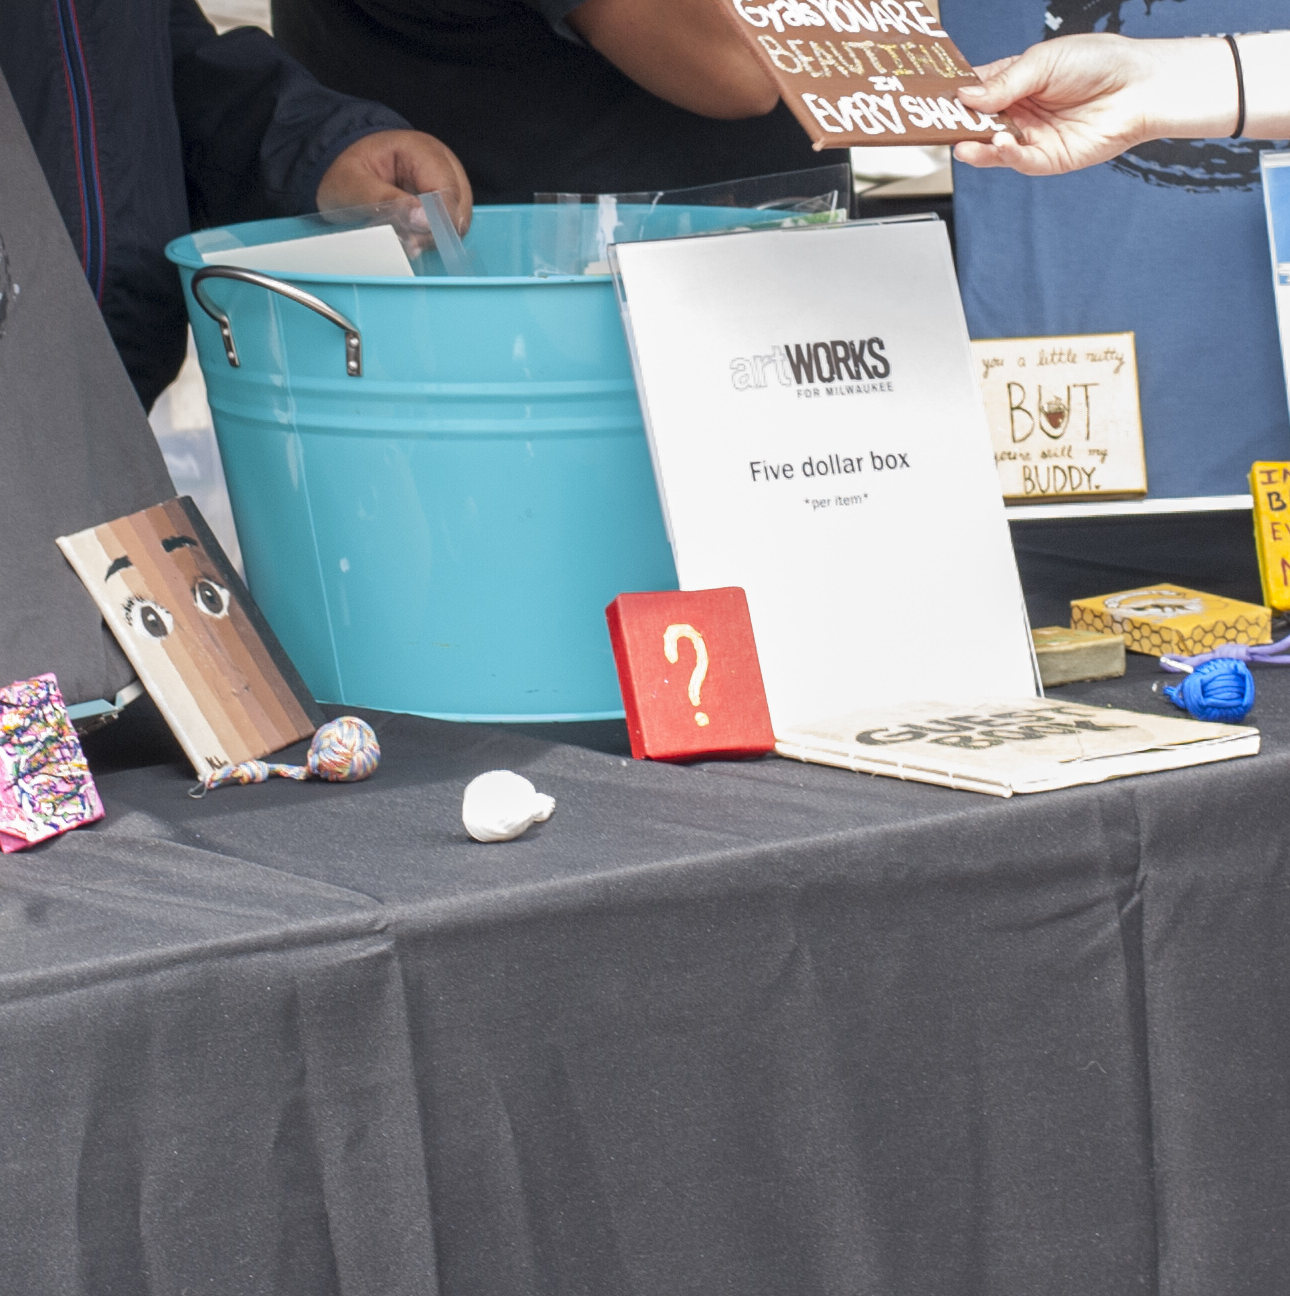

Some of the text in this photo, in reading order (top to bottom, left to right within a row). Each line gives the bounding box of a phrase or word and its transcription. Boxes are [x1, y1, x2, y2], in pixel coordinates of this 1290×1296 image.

[757, 34, 976, 79] BEAUTIFUL
[801, 92, 907, 135] EVERY
[729, 336, 891, 391] artWORKS
[1037, 347, 1077, 366] little
[797, 381, 894, 400] FOR MILWAUKEE
[1007, 381, 1101, 444] BUT
[750, 450, 911, 482] Five dollar box
[856, 707, 1097, 746] GUEST
[926, 719, 1138, 750] BOOK
